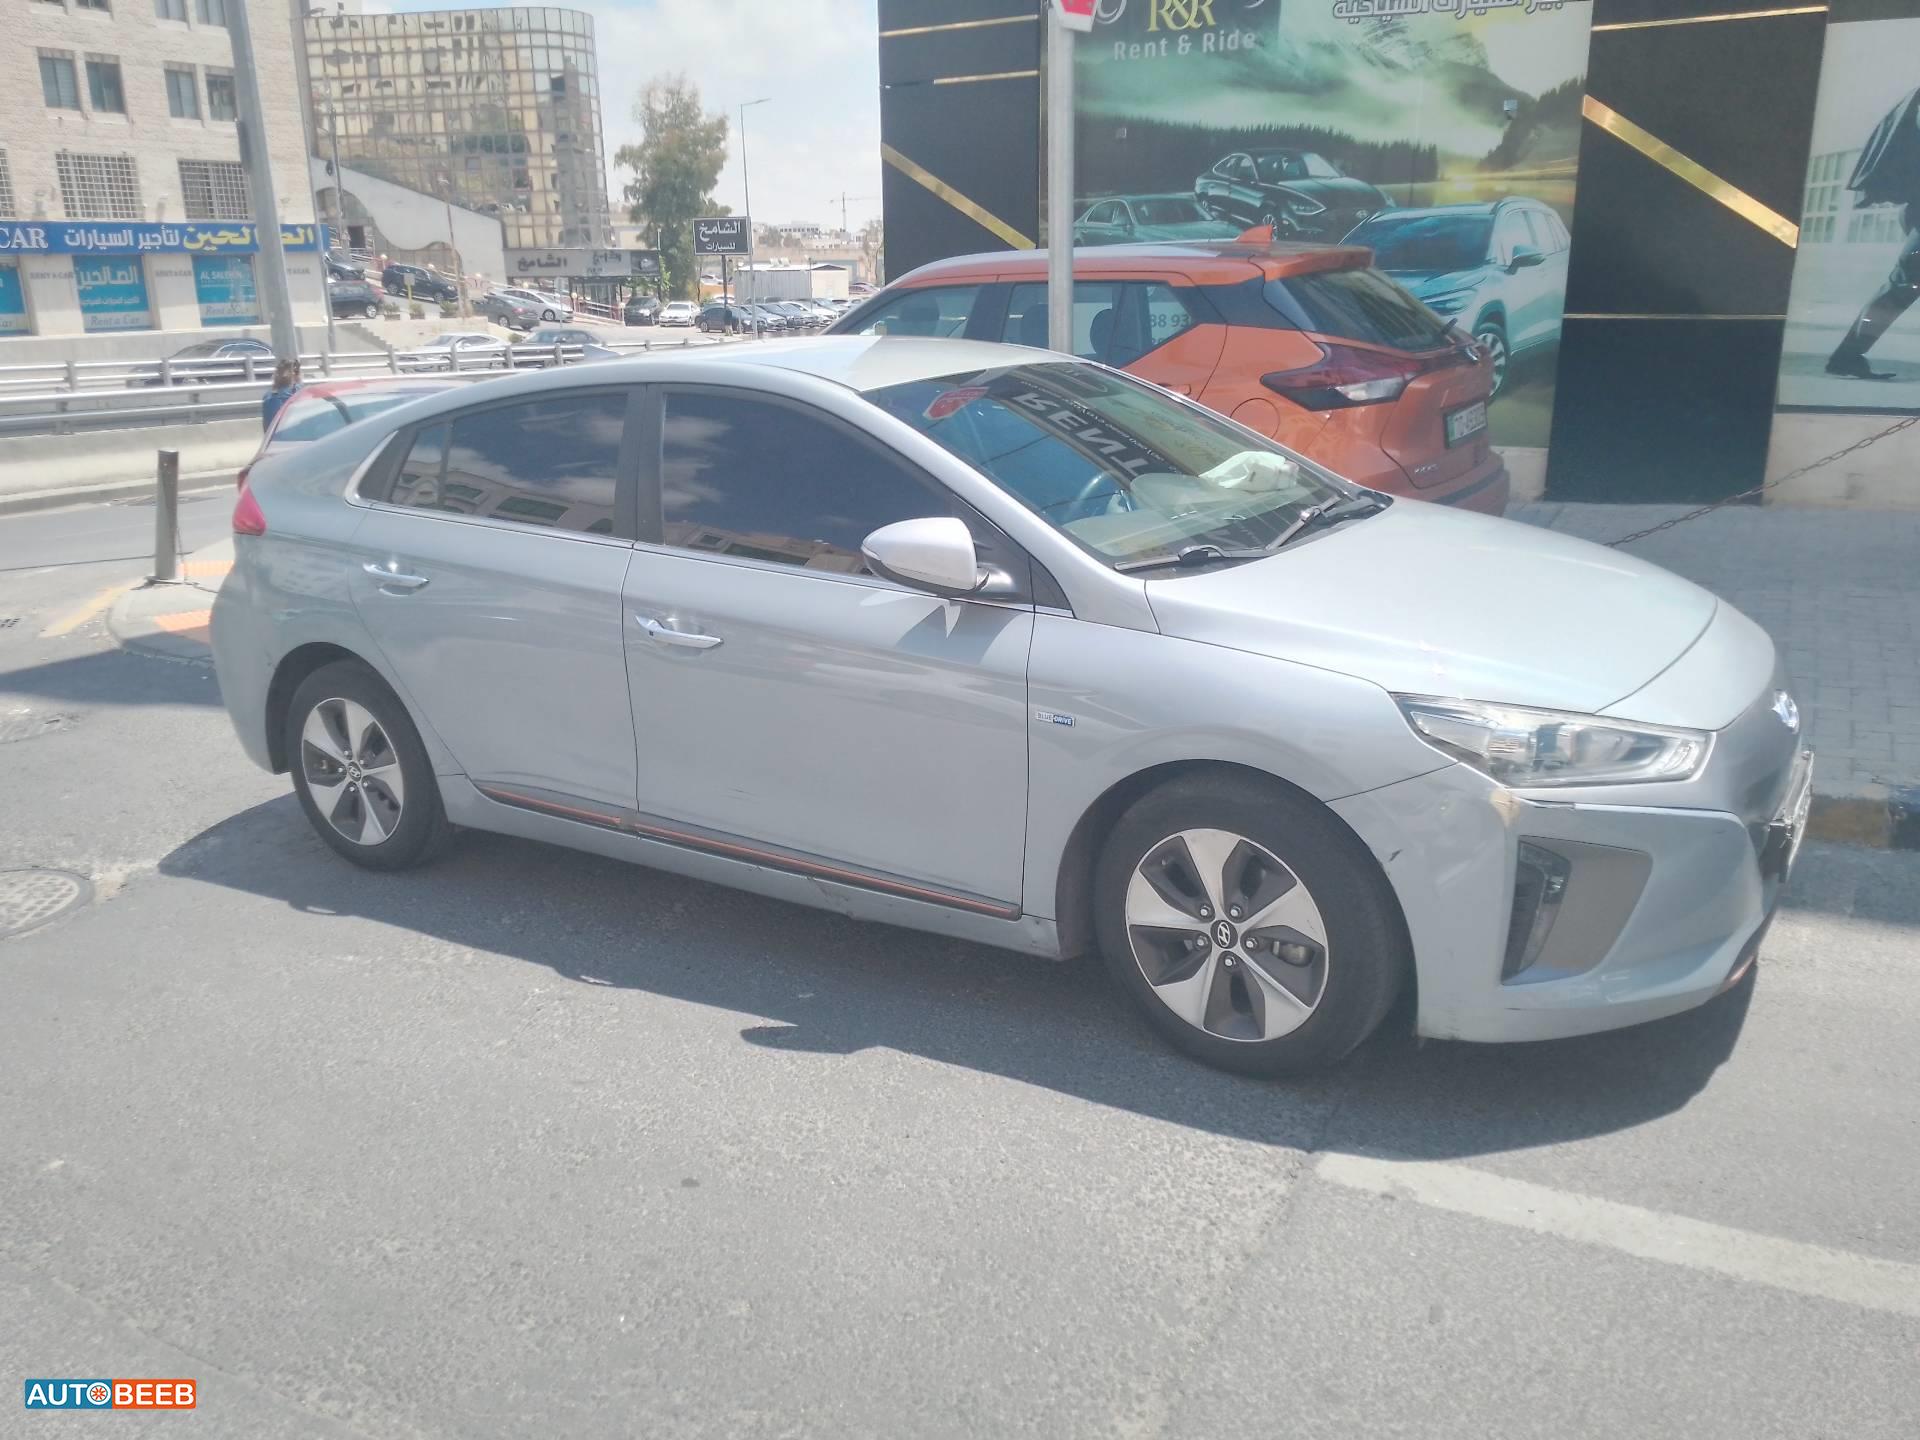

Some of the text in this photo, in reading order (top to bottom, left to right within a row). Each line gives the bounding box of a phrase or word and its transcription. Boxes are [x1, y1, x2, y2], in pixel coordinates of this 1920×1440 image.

[1114, 29, 1256, 61] Rent & Ride
[64, 228, 134, 250] السيارات
[138, 226, 180, 250] لتأجير
[698, 220, 741, 242] الشامخ
